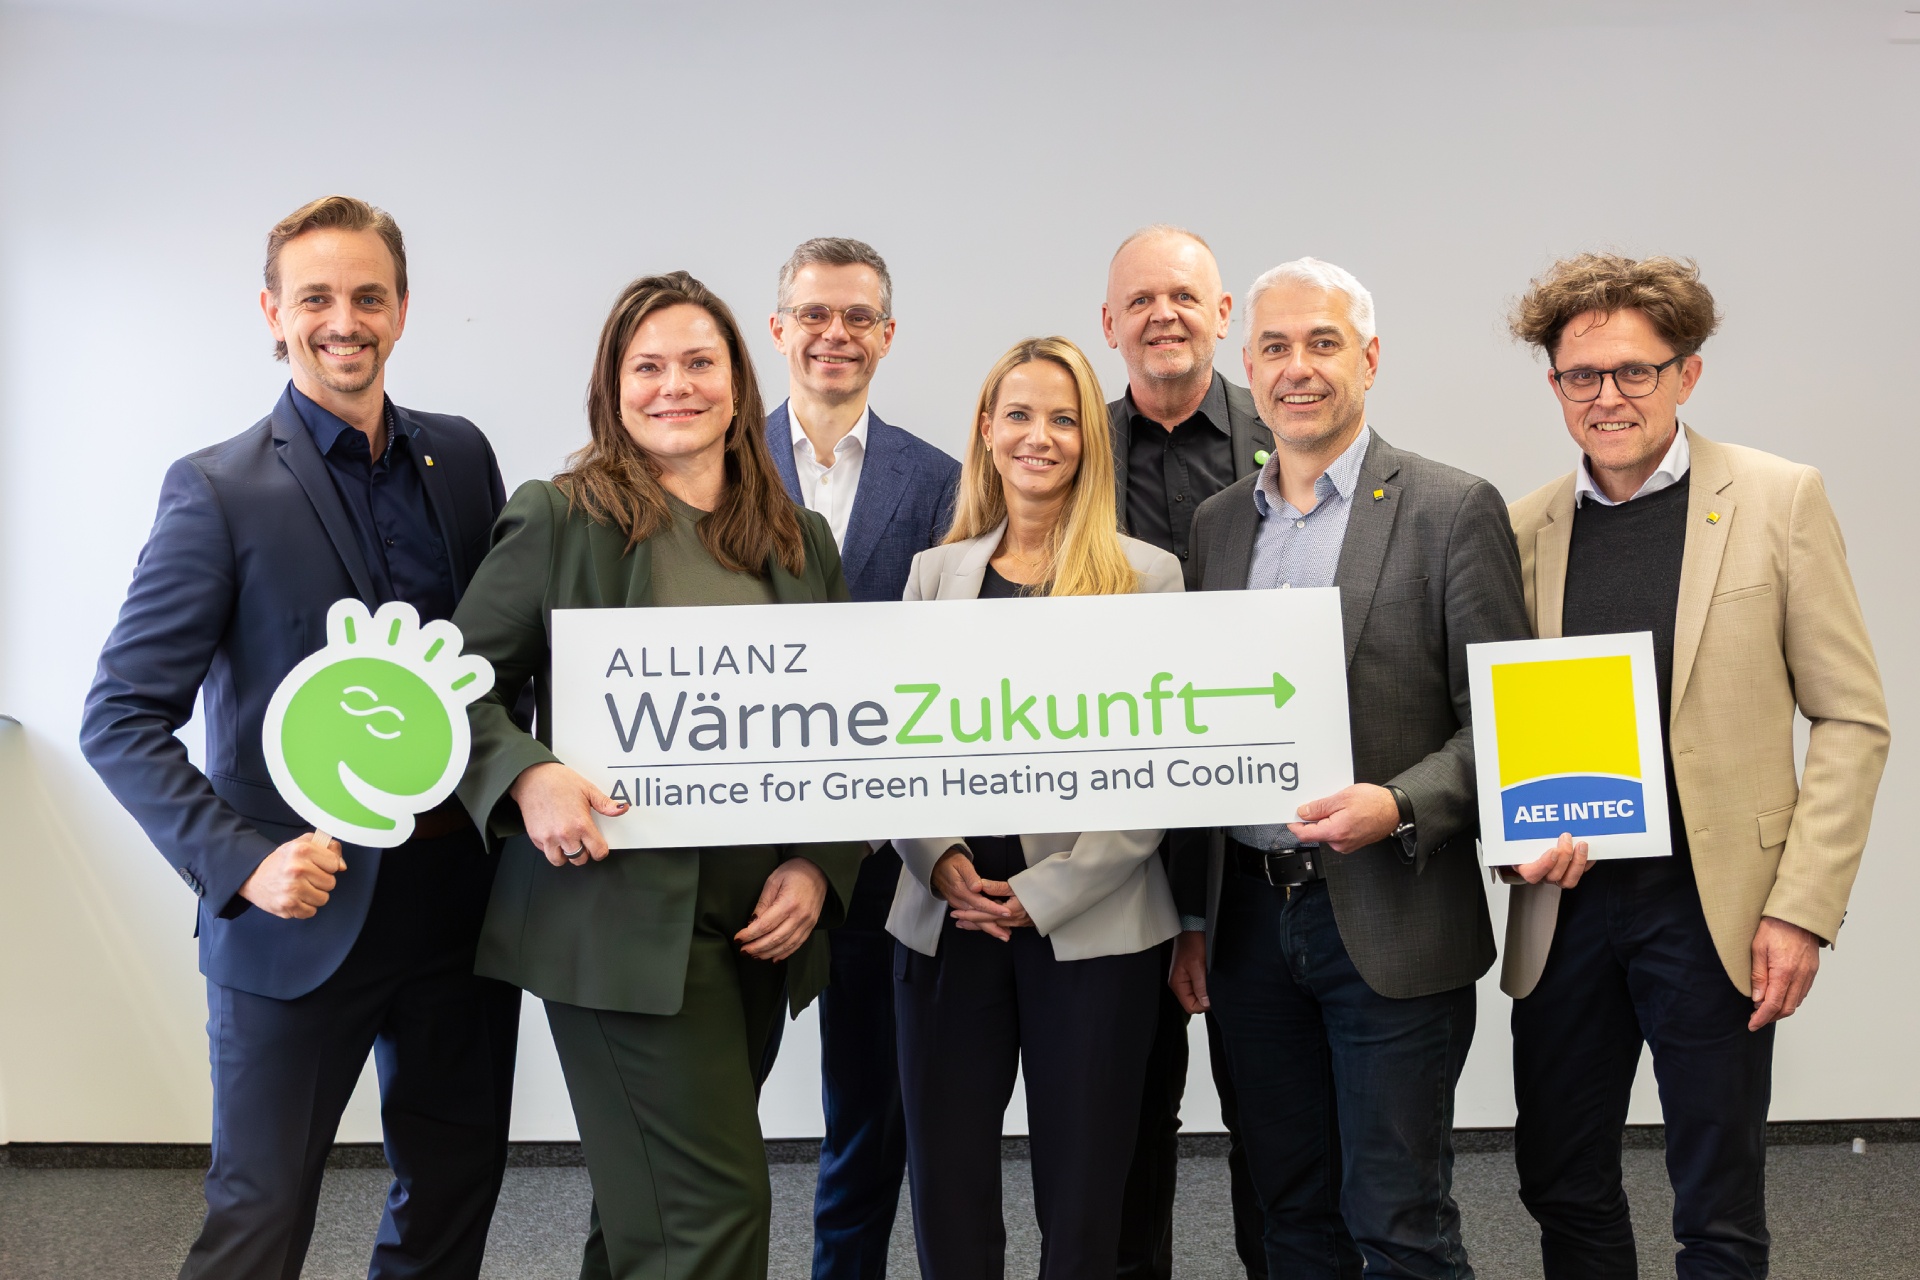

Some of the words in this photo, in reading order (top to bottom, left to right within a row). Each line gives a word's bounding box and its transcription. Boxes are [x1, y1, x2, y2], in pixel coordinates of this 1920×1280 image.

[605, 643, 808, 678] ALLIANZ
[604, 671, 1209, 753] WärmeZukunft
[610, 777, 749, 808] Alliance
[760, 773, 812, 803] for
[822, 771, 929, 801] Green
[942, 765, 1078, 801] Heating
[1090, 759, 1155, 791] and
[1166, 756, 1300, 791] Cooling
[1513, 803, 1560, 824] AEE
[1563, 799, 1635, 821] INTEC
